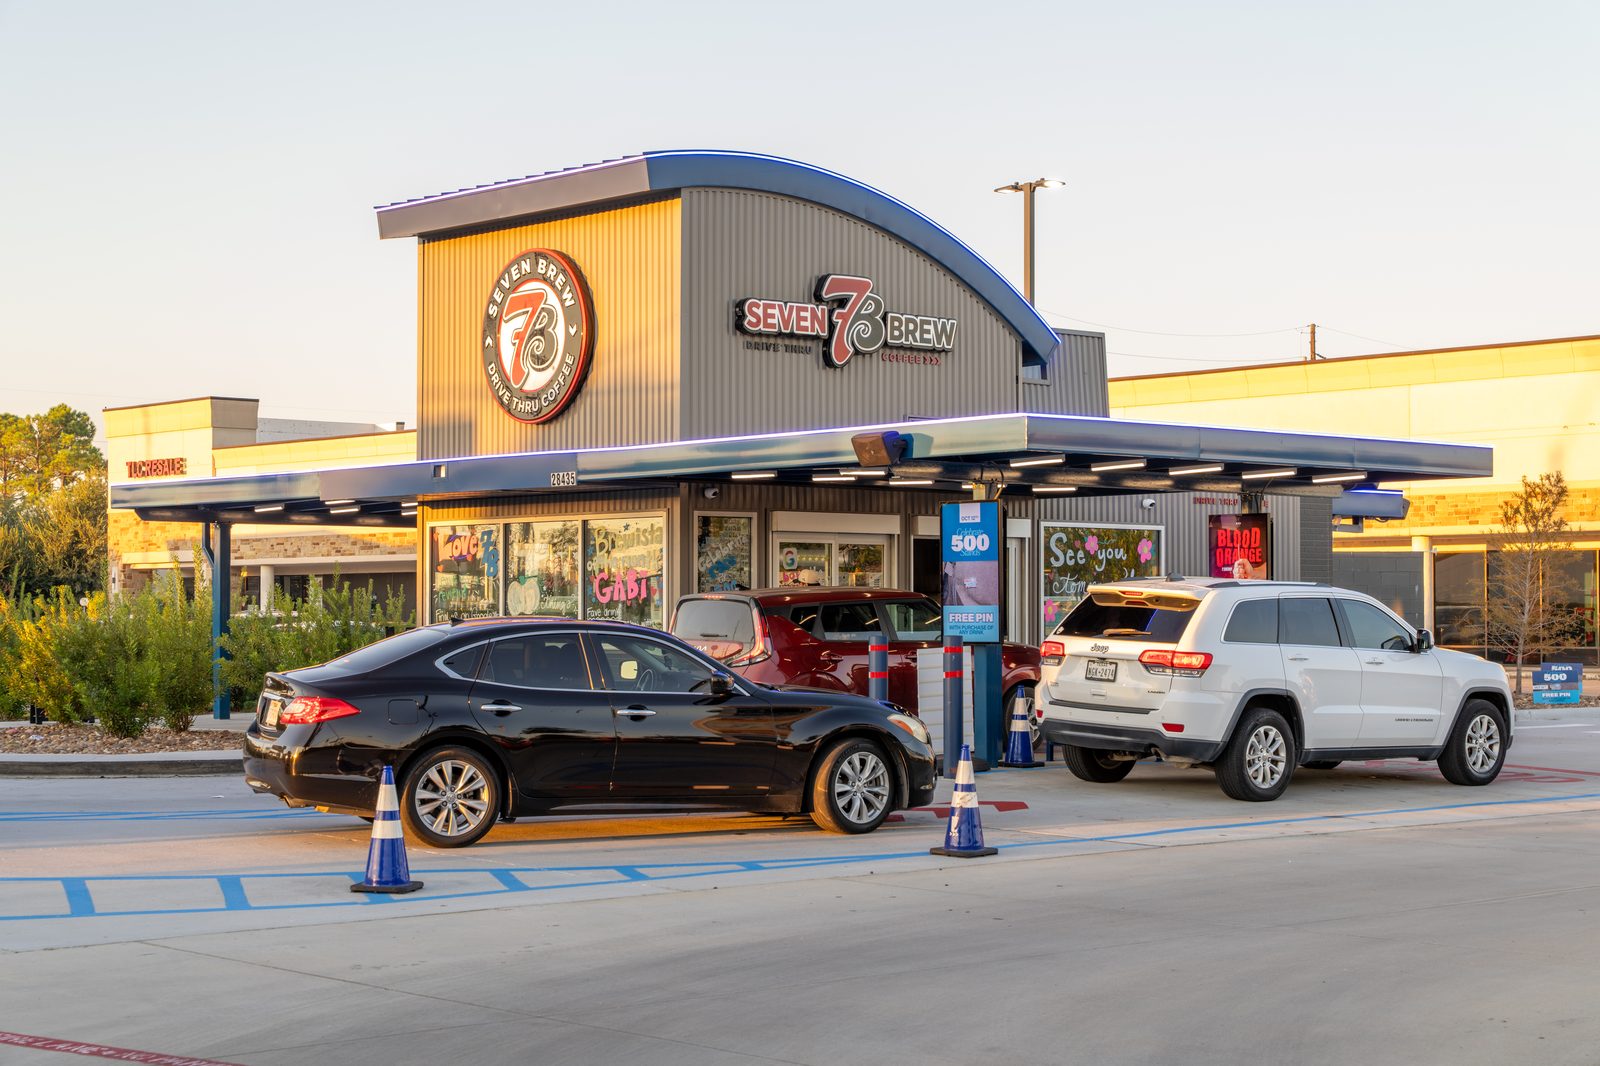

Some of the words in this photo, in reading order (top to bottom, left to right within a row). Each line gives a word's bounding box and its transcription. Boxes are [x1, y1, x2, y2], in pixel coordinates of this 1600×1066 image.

[488, 258, 531, 318] SEVEN
[537, 258, 576, 308] BREW
[743, 298, 828, 337] SEVEN
[886, 312, 958, 350] BREW
[743, 340, 781, 352] DRIVE
[784, 343, 812, 356] THRU
[881, 352, 921, 365] COFFEE
[488, 362, 511, 405] DRIVE
[512, 396, 539, 413] THRU
[541, 353, 575, 406] COFFEE
[145, 457, 183, 477] RESALE
[551, 472, 576, 486] 28435
[951, 533, 990, 552] 500
[1217, 527, 1261, 548] BLOOD
[1049, 532, 1086, 568] See
[1095, 547, 1127, 572] you
[1215, 547, 1263, 568] ORANGE
[949, 613, 975, 623] FREE
[976, 613, 994, 623] PIN
[1090, 643, 1110, 654] Jeep
[1543, 673, 1568, 682] 500
